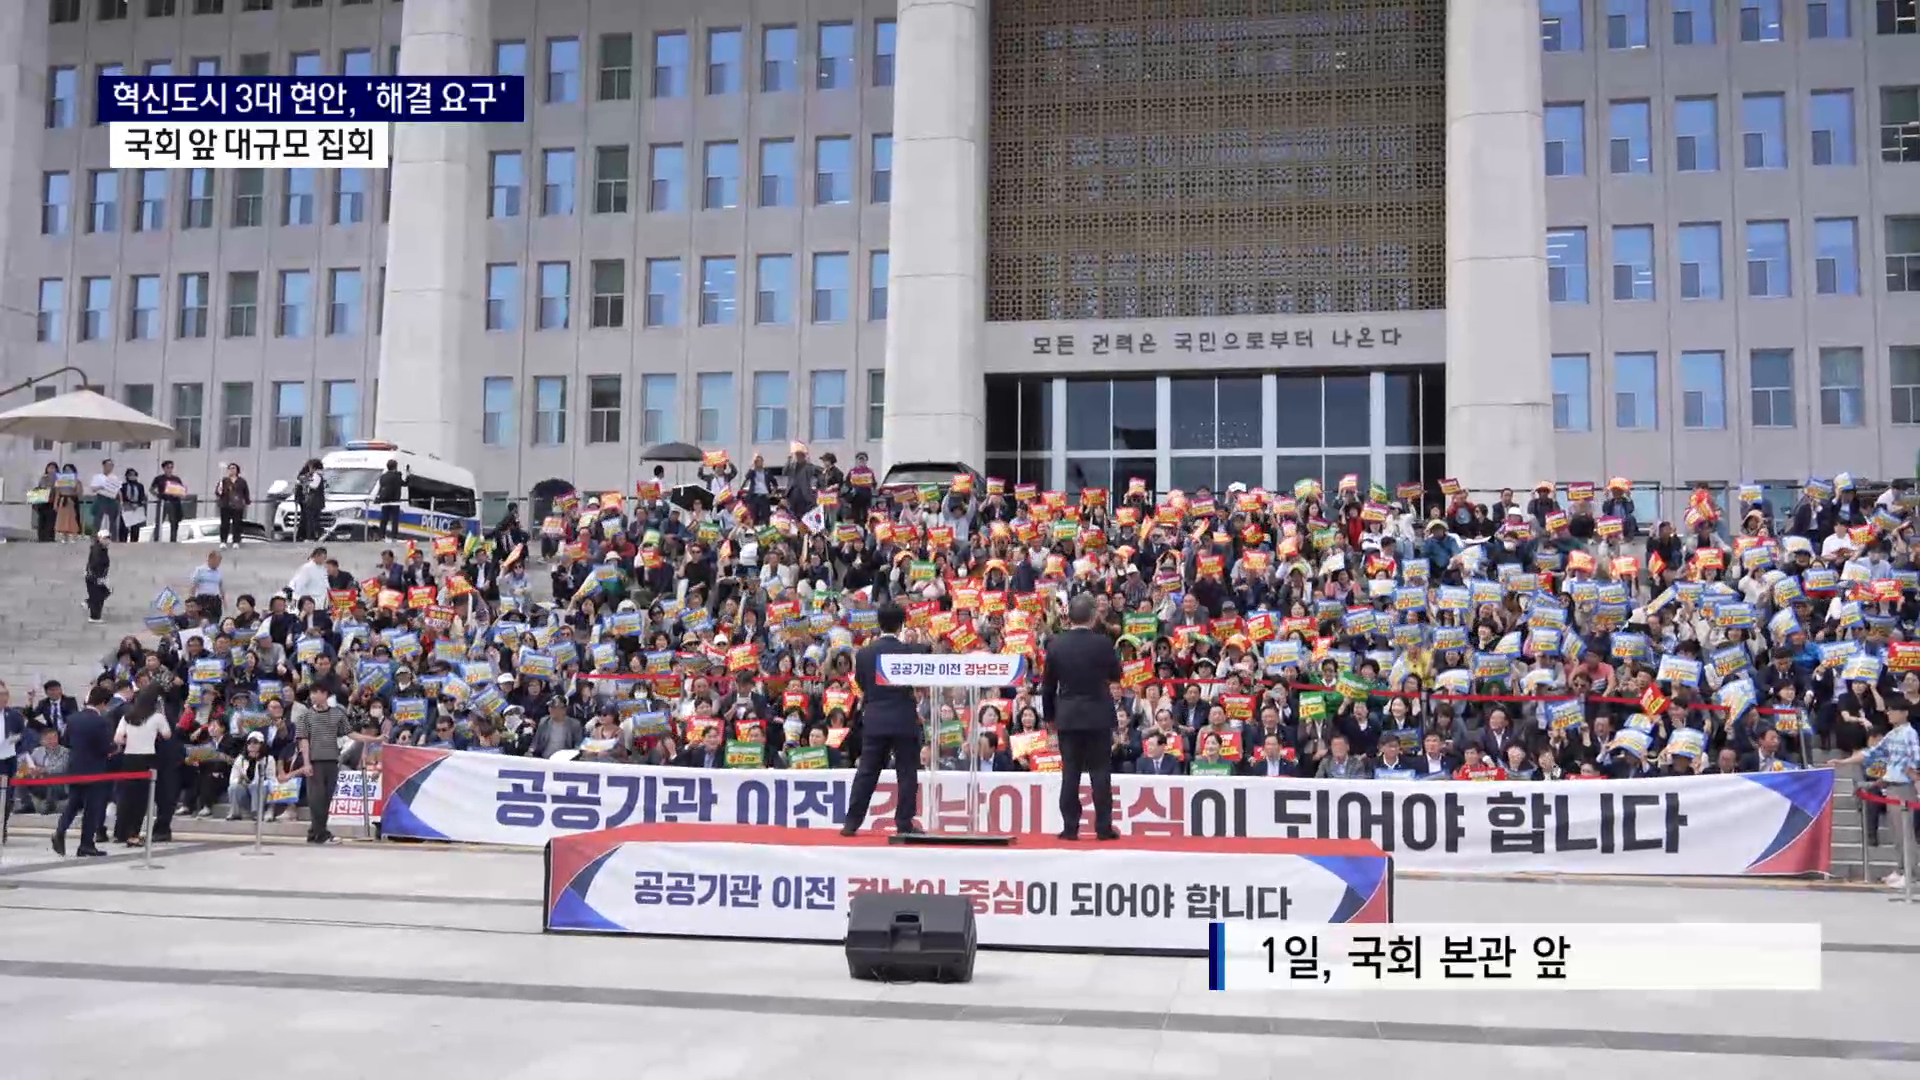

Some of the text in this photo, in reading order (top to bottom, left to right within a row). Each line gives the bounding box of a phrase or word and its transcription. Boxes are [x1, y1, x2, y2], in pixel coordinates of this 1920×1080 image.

[1033, 327, 1403, 355] 모든 권력은 국민으로부터 나온다
[420, 514, 453, 533] POLIC
[890, 662, 1010, 676] 공공기관 이전 경남으로
[496, 769, 718, 830] 공공기관
[736, 779, 850, 828] 이전
[1274, 789, 1465, 853] 되어야
[1487, 791, 1688, 854] 합니다
[633, 871, 762, 908] 공공기관
[772, 876, 836, 911] 이전
[959, 879, 1058, 916] 중심이
[1070, 882, 1175, 919] 되어야
[1186, 884, 1293, 920] 합니다
